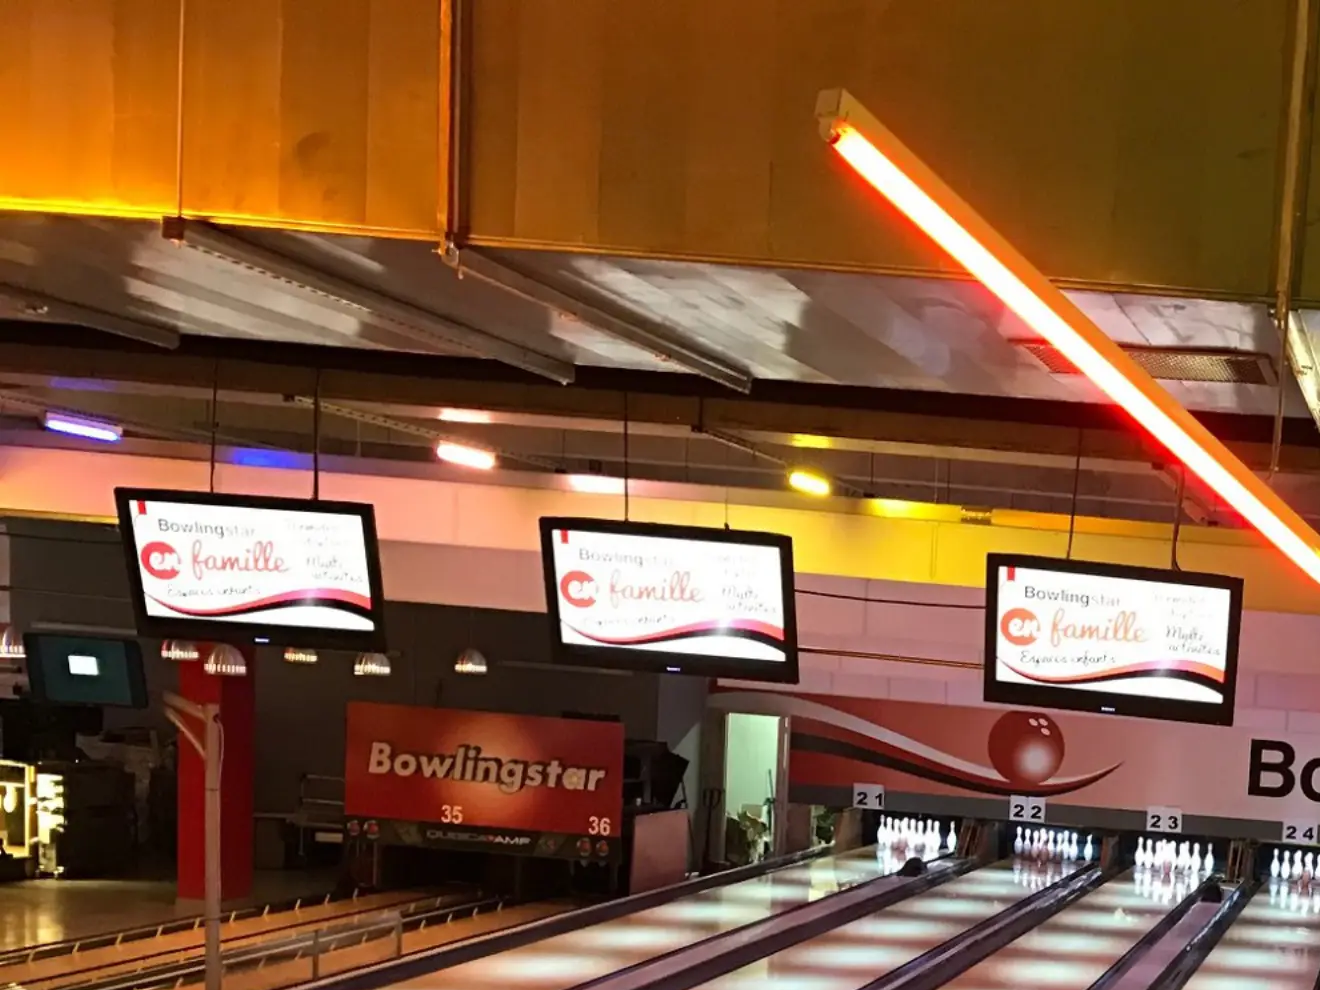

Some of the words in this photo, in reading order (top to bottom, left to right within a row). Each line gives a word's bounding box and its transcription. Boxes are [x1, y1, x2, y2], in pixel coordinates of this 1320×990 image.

[191, 539, 289, 580] famille
[609, 569, 706, 609] famille
[1024, 585, 1120, 607] Bowlingstar
[1050, 607, 1149, 648] famille
[368, 741, 606, 794] Bowlingstar
[856, 792, 884, 806] 21
[441, 804, 463, 824] 35
[1013, 804, 1042, 819] 22
[588, 816, 611, 836] 36
[1150, 814, 1179, 830] 23
[1286, 825, 1314, 841] 24
